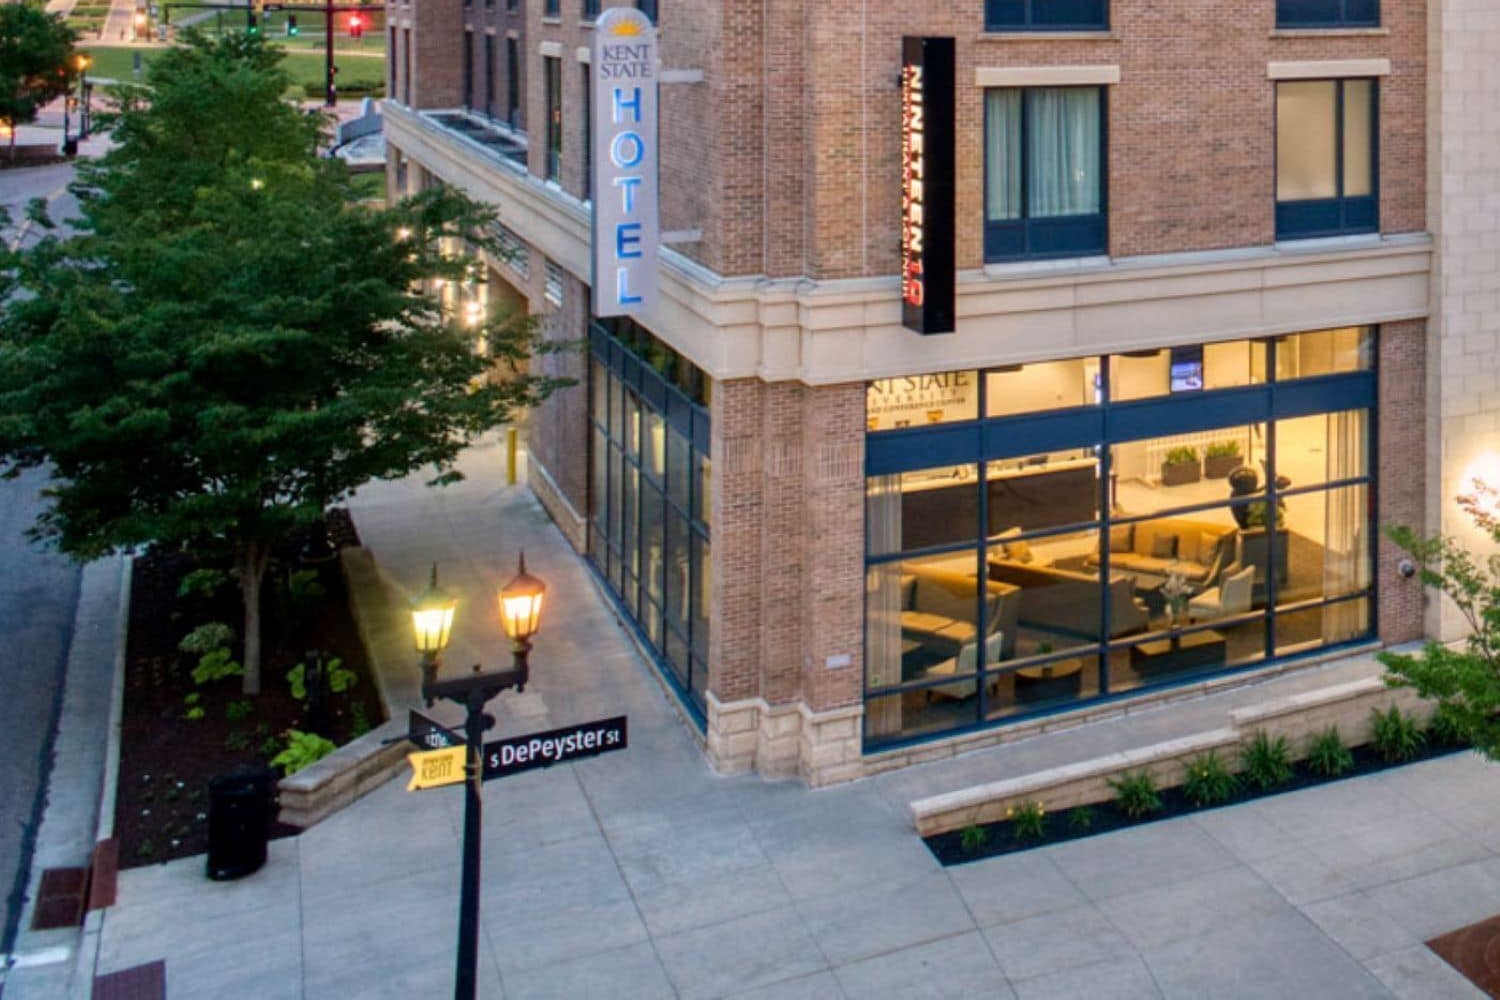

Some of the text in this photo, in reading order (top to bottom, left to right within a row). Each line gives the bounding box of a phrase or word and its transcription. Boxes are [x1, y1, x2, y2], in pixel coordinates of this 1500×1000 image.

[601, 45, 650, 62] KENT
[600, 62, 650, 79] STATE
[610, 87, 645, 305] HOTEL
[501, 728, 605, 764] DePeyster
[606, 729, 620, 744] St
